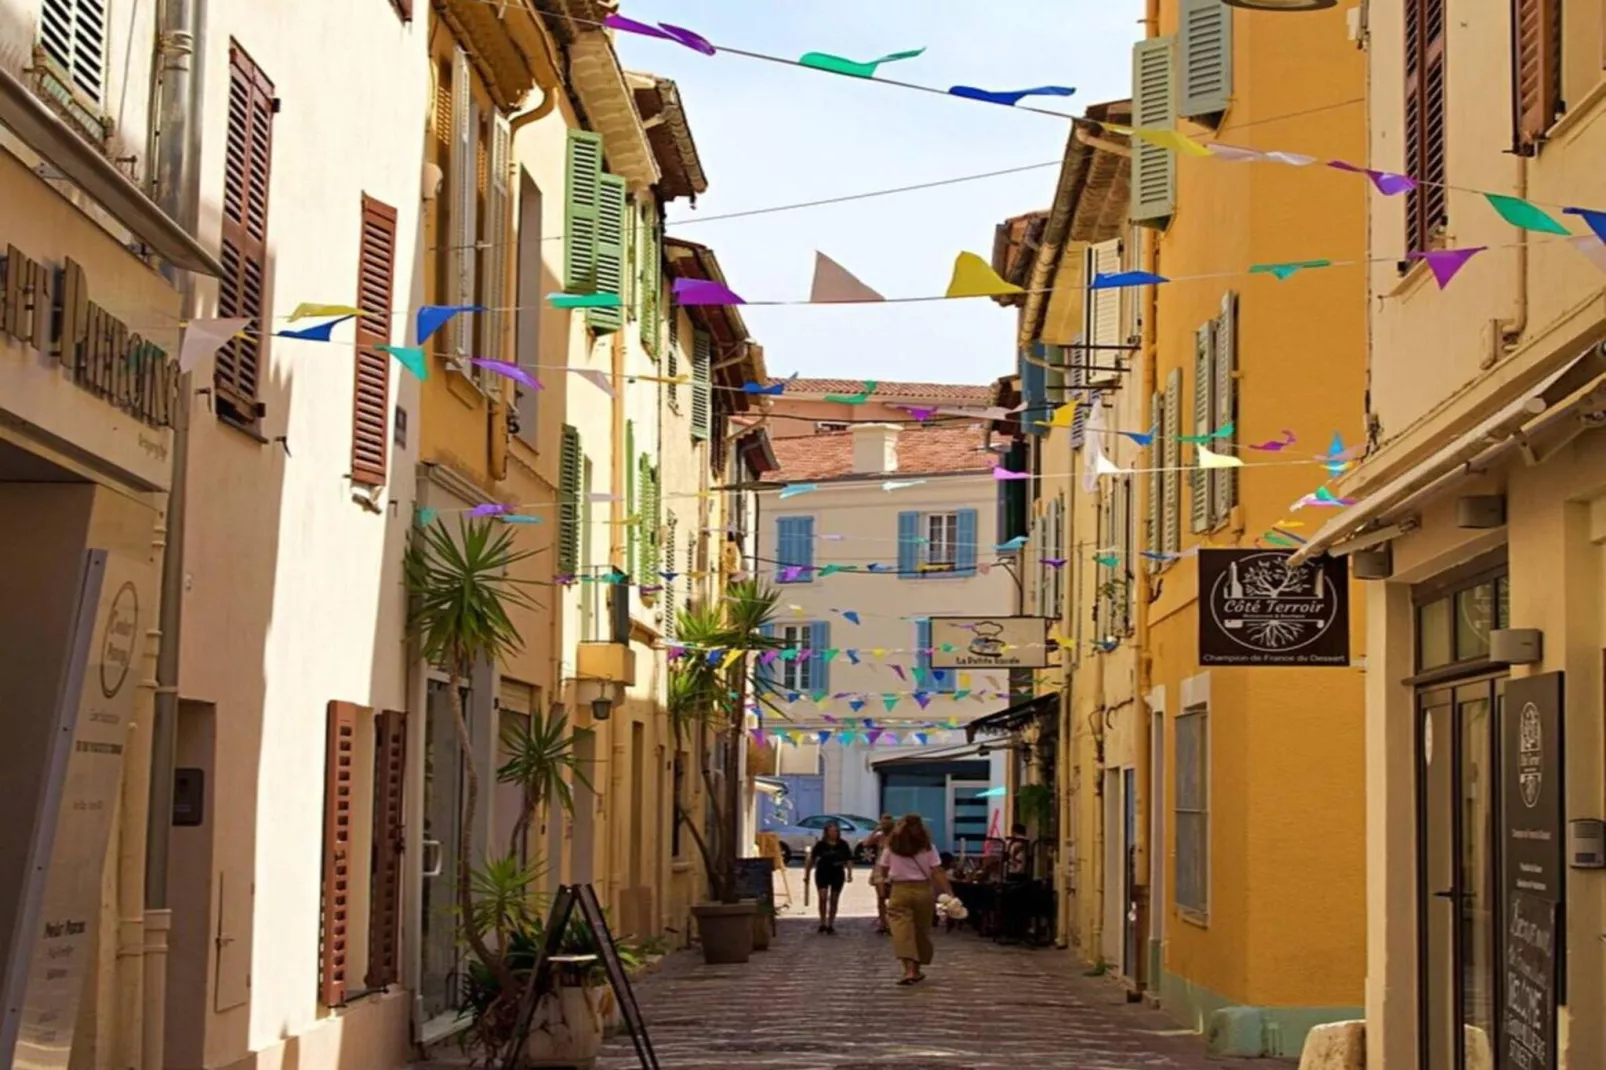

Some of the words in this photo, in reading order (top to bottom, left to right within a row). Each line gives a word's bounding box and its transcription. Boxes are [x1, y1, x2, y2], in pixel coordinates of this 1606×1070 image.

[1223, 599, 1261, 614] Côté
[1265, 600, 1325, 614] Terroir
[1250, 653, 1261, 661] de
[1263, 653, 1294, 661] France
